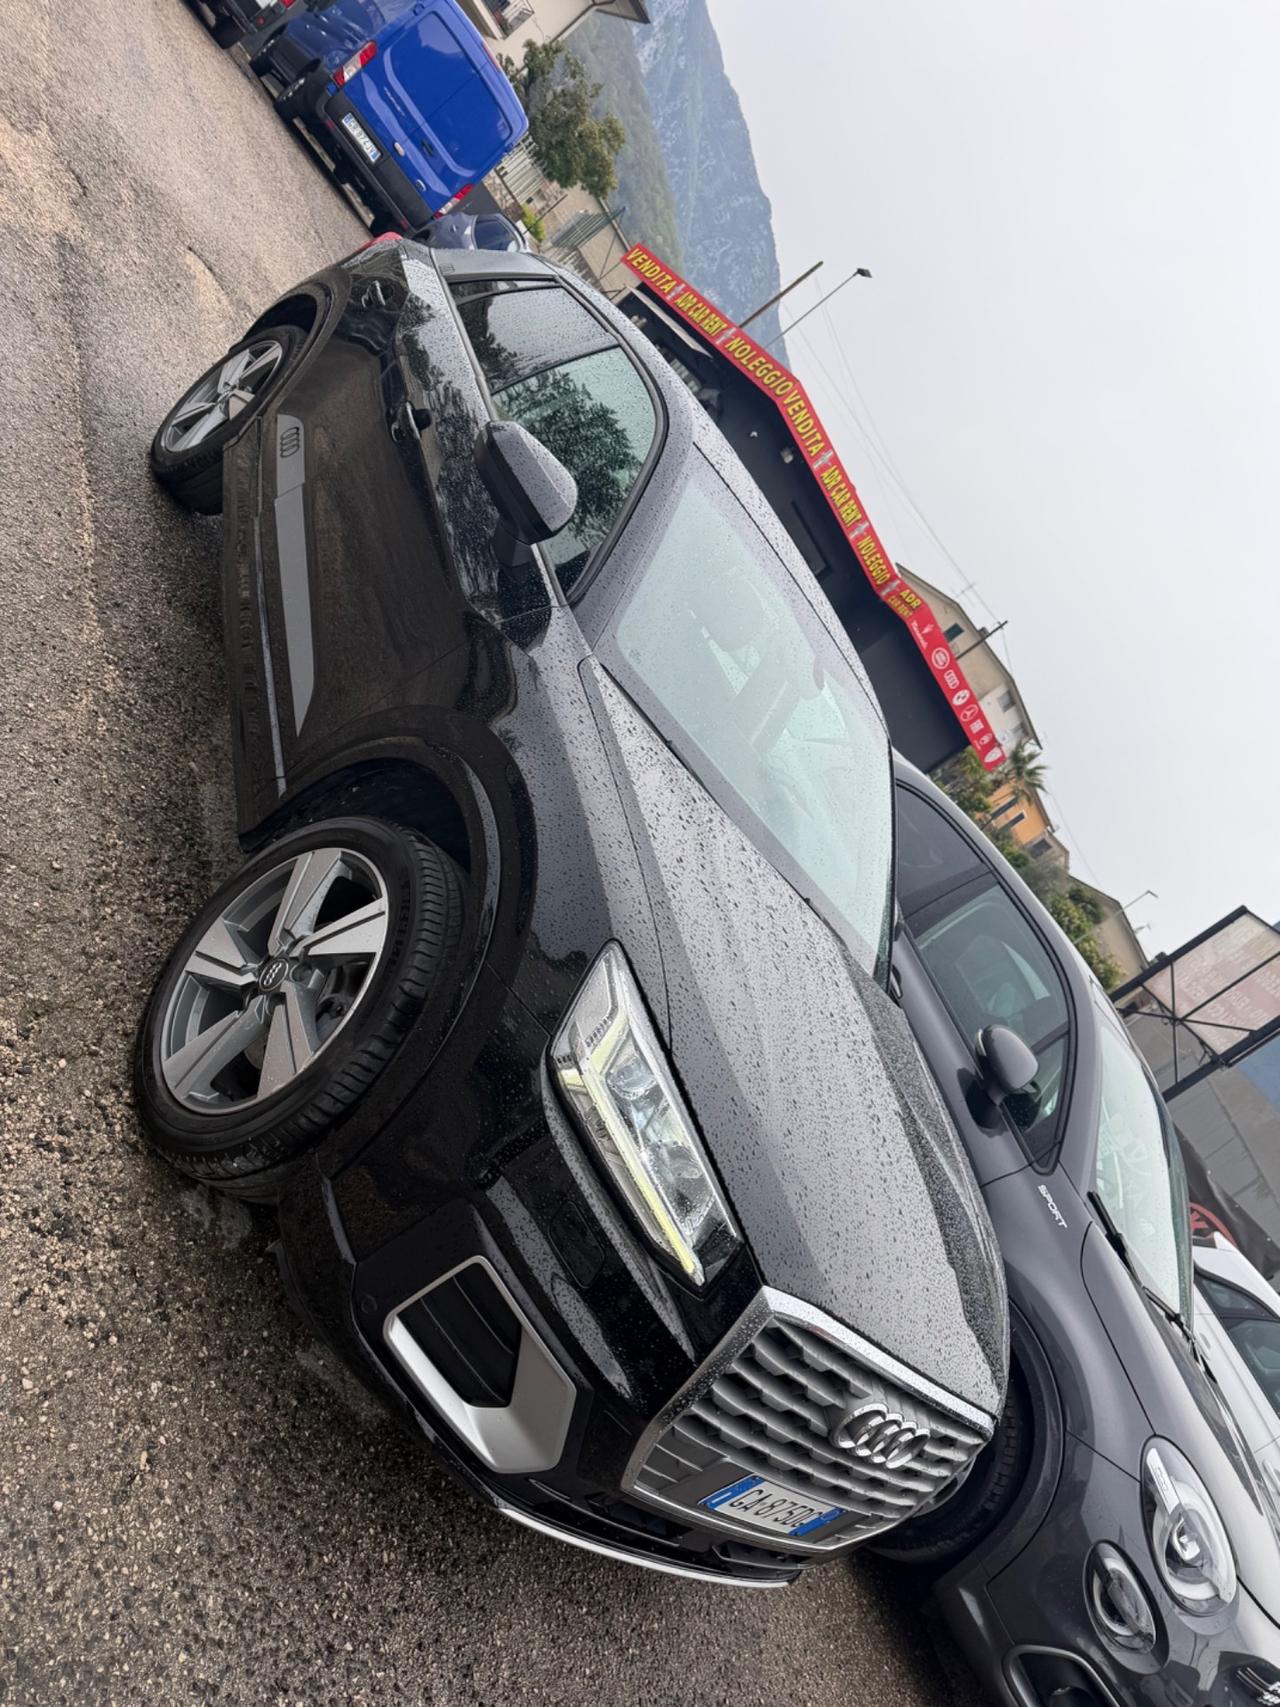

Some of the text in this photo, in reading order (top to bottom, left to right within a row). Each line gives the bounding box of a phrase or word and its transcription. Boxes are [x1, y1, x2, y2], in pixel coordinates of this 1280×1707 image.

[627, 248, 677, 293] VENDITA
[687, 302, 710, 324] CAR
[700, 313, 728, 336] RENT
[725, 337, 793, 396] NOLEGGIO
[783, 389, 890, 584] VENDITA ADR CAR RENT NOLEGGIO
[899, 589, 921, 608] ADR
[1038, 1184, 1068, 1229] SPORT
